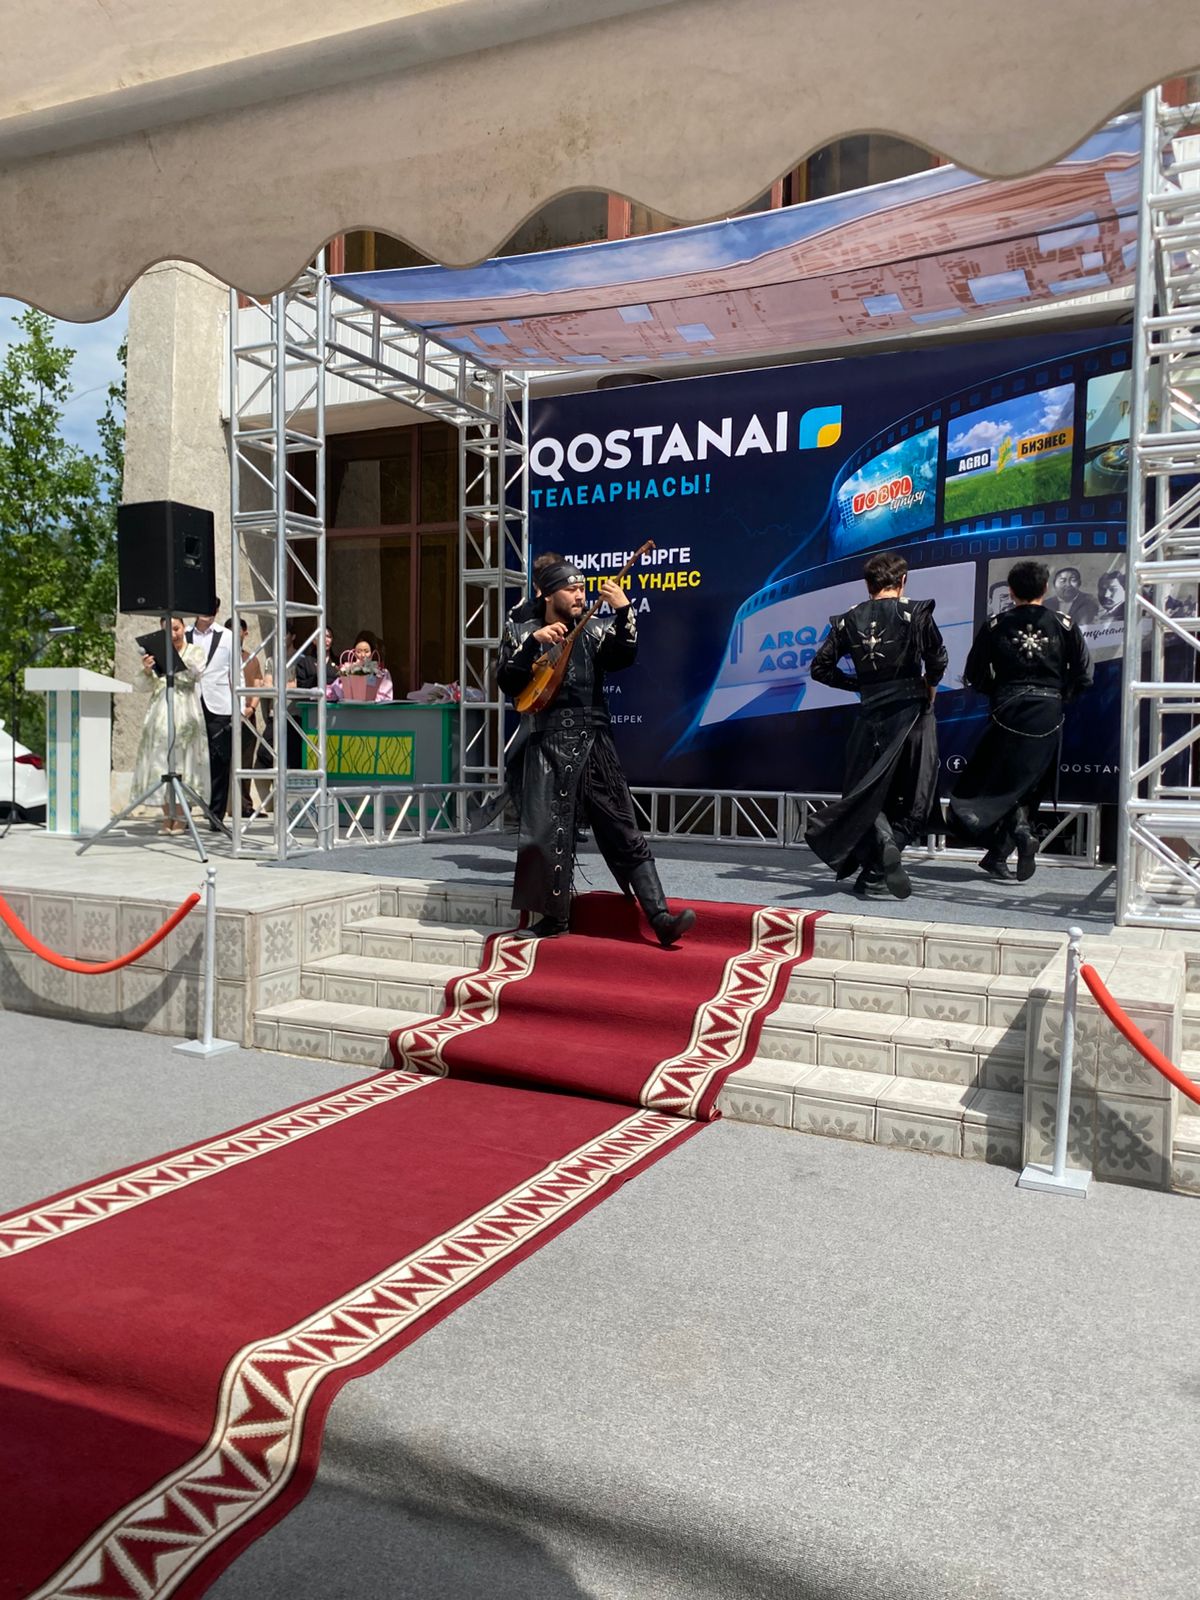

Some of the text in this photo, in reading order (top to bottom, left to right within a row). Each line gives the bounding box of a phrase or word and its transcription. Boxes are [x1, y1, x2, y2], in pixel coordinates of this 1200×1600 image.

[529, 411, 788, 481] QOSTANAI
[1021, 433, 1066, 456] БИЗНЕС
[958, 453, 989, 473] AGRO
[531, 473, 711, 508] ТЕЛЕАРНАСЫ!
[853, 475, 913, 515] TOBYL
[758, 648, 816, 673] AQP
